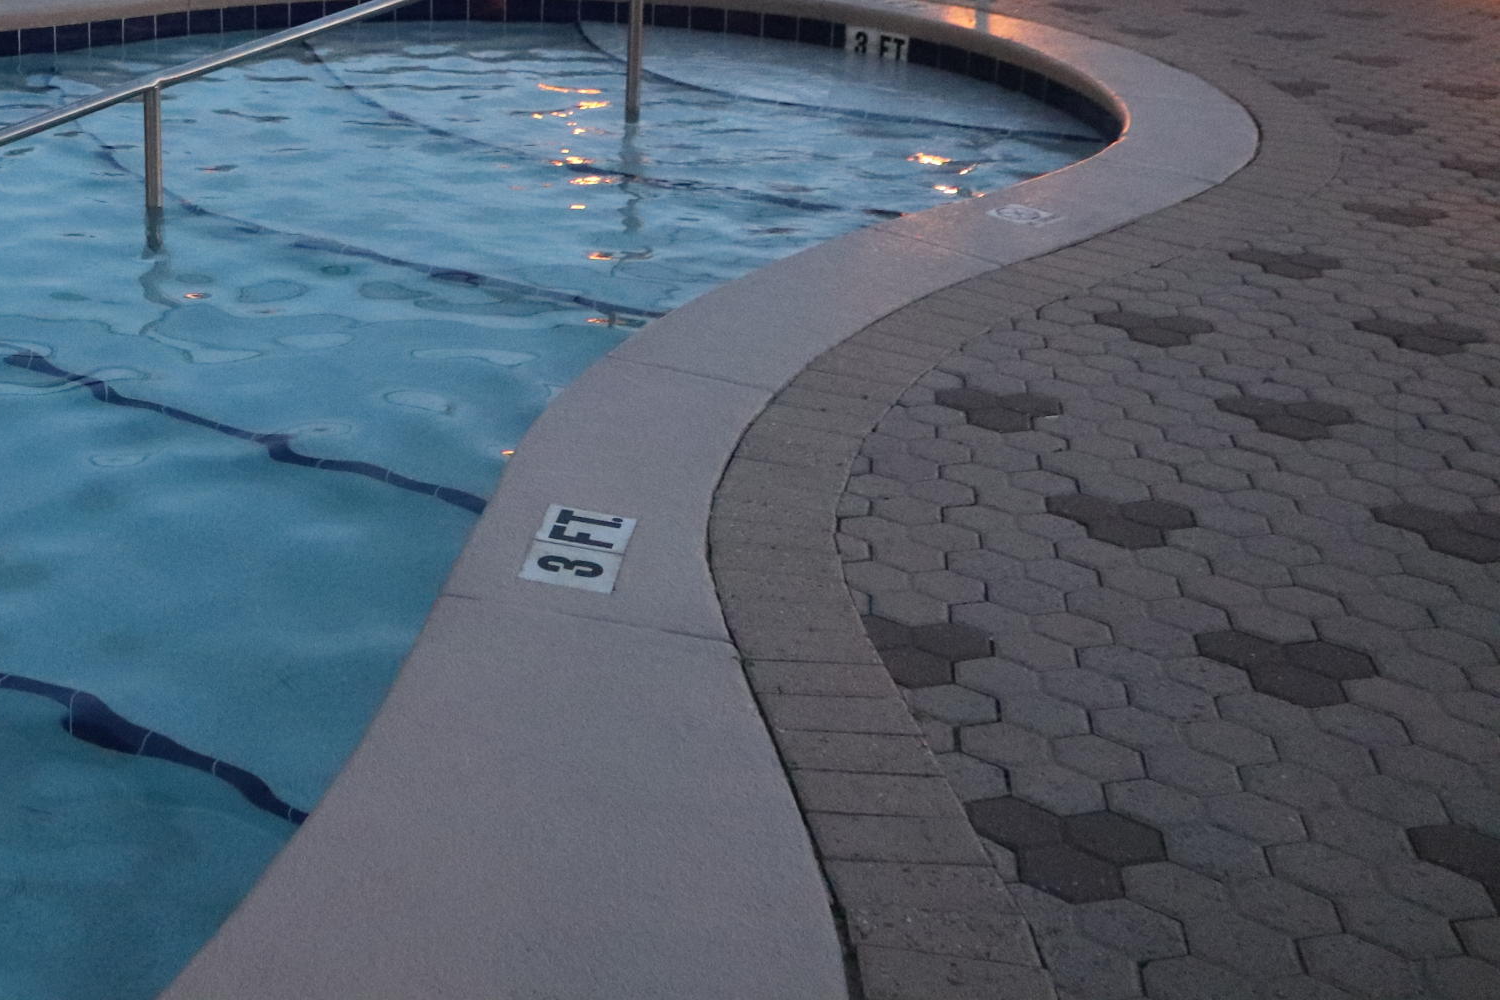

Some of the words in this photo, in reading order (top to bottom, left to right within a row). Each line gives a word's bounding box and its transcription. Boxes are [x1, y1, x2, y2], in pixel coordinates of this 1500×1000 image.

[854, 31, 868, 53] 3
[880, 34, 905, 60] FT
[537, 555, 603, 577] 3
